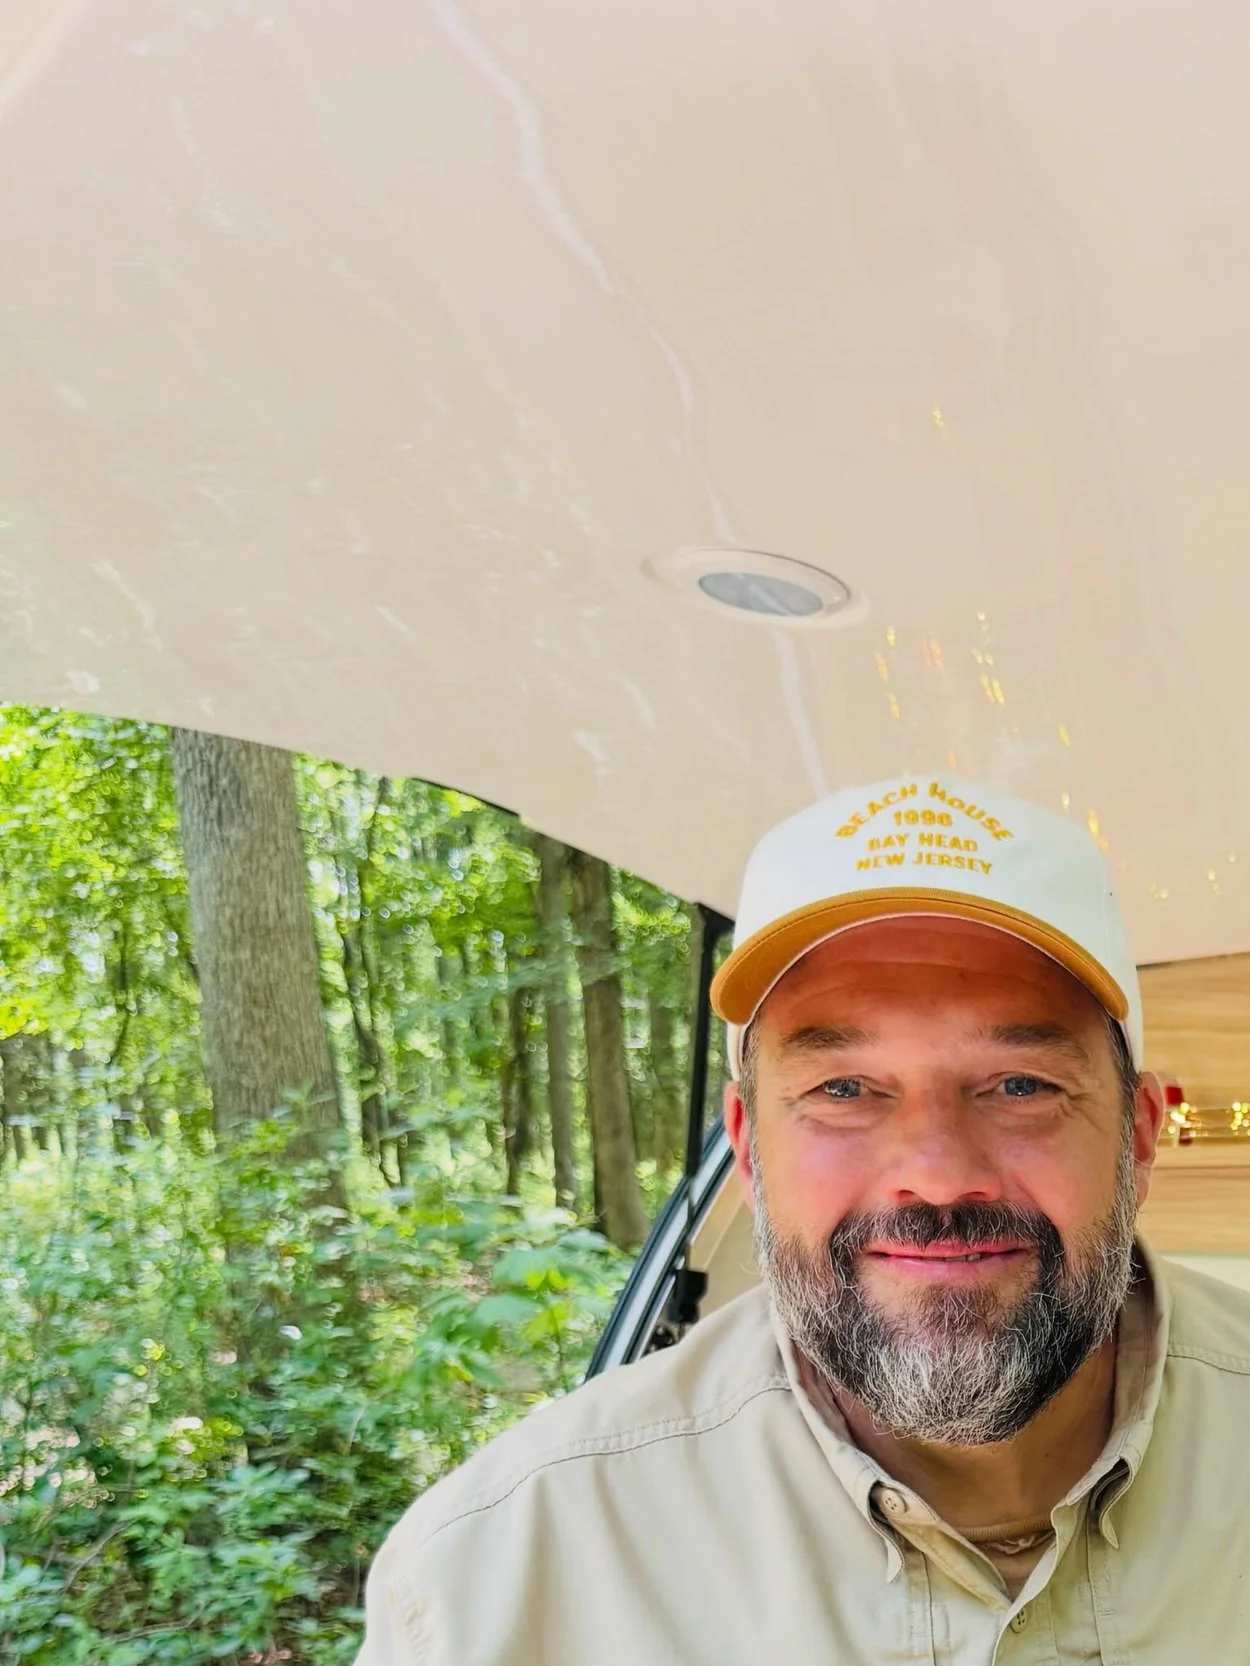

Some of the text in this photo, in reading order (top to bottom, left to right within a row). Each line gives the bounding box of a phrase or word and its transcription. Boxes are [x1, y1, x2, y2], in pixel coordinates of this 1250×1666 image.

[835, 781, 1015, 841] BEACH HOUSE
[868, 832, 978, 851] BAY HEAD
[856, 852, 992, 874] NEW JERSEY
